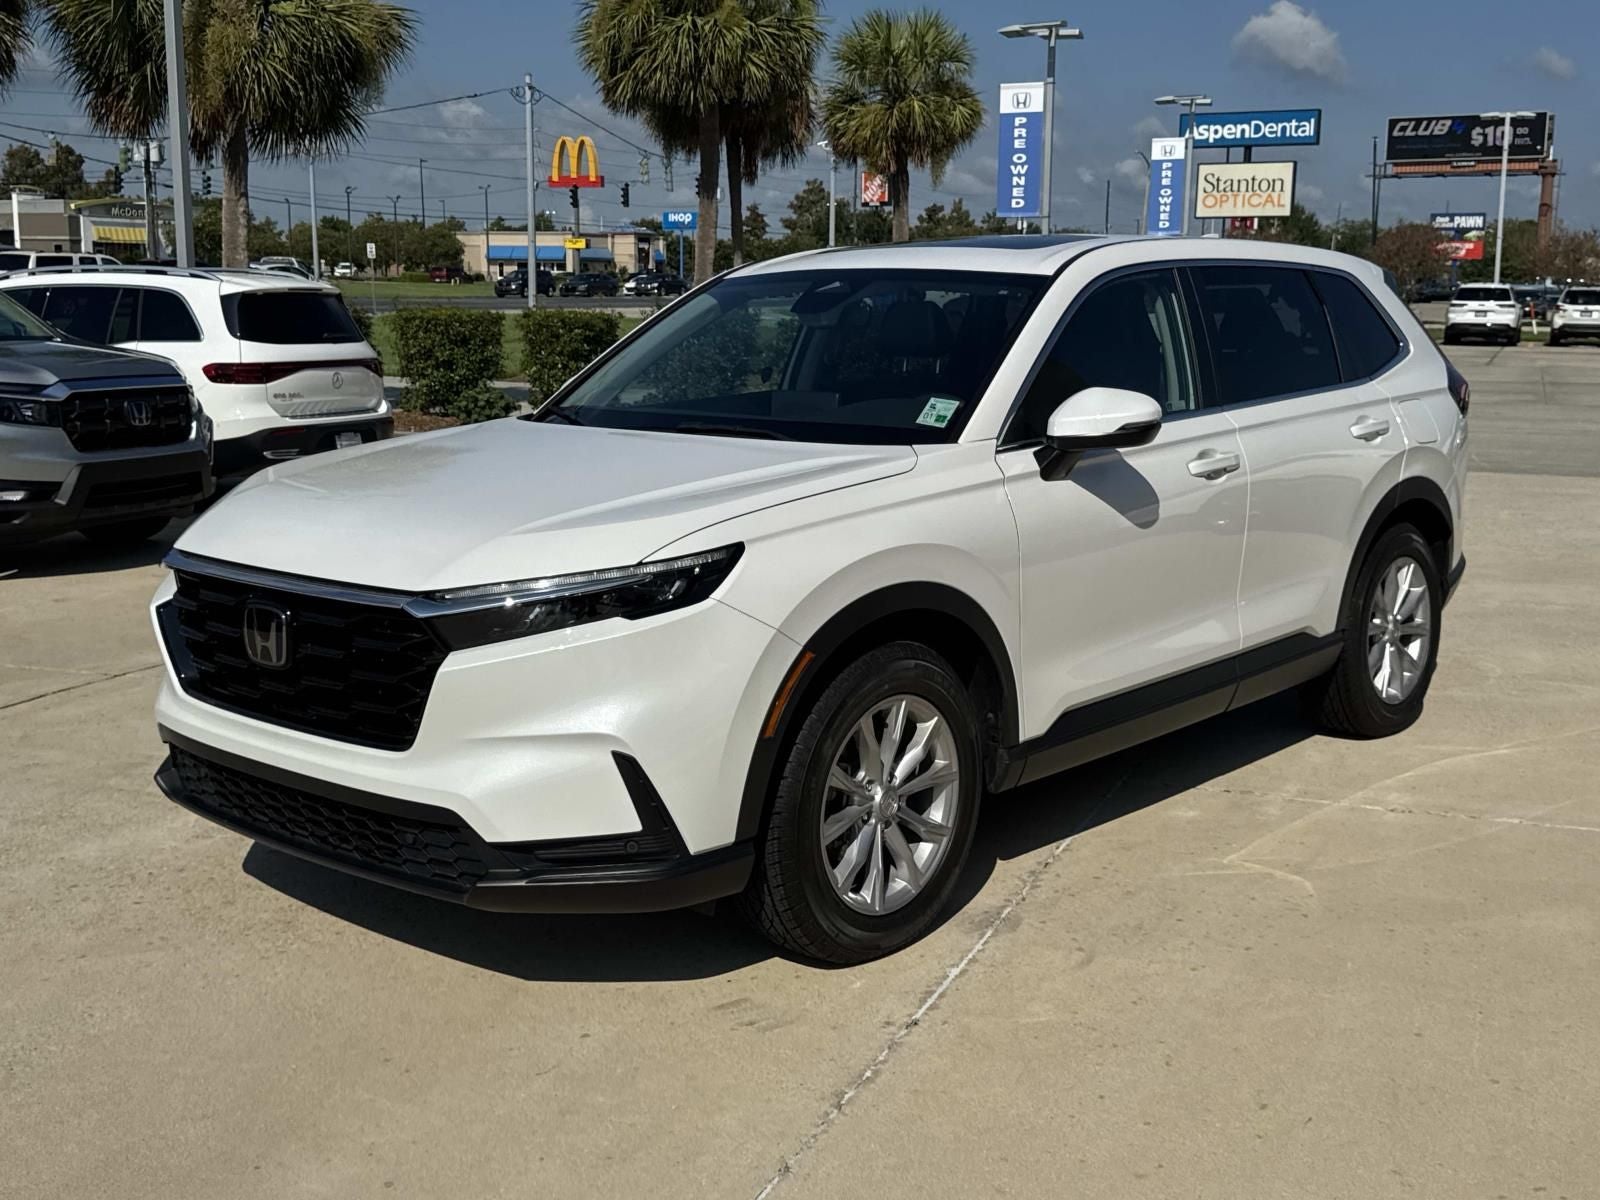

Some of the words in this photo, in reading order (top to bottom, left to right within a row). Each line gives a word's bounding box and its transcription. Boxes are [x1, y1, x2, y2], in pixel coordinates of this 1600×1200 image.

[1013, 116, 1028, 149] PRE
[1392, 119, 1452, 137] CLUB
[1010, 153, 1029, 209] OWNED
[1161, 162, 1173, 186] PRE
[1203, 173, 1285, 194] Stanton
[1158, 188, 1174, 229] OWNED
[1202, 193, 1286, 209] OPTICAL
[111, 206, 149, 218] McDon
[1453, 215, 1485, 228] PAWN
